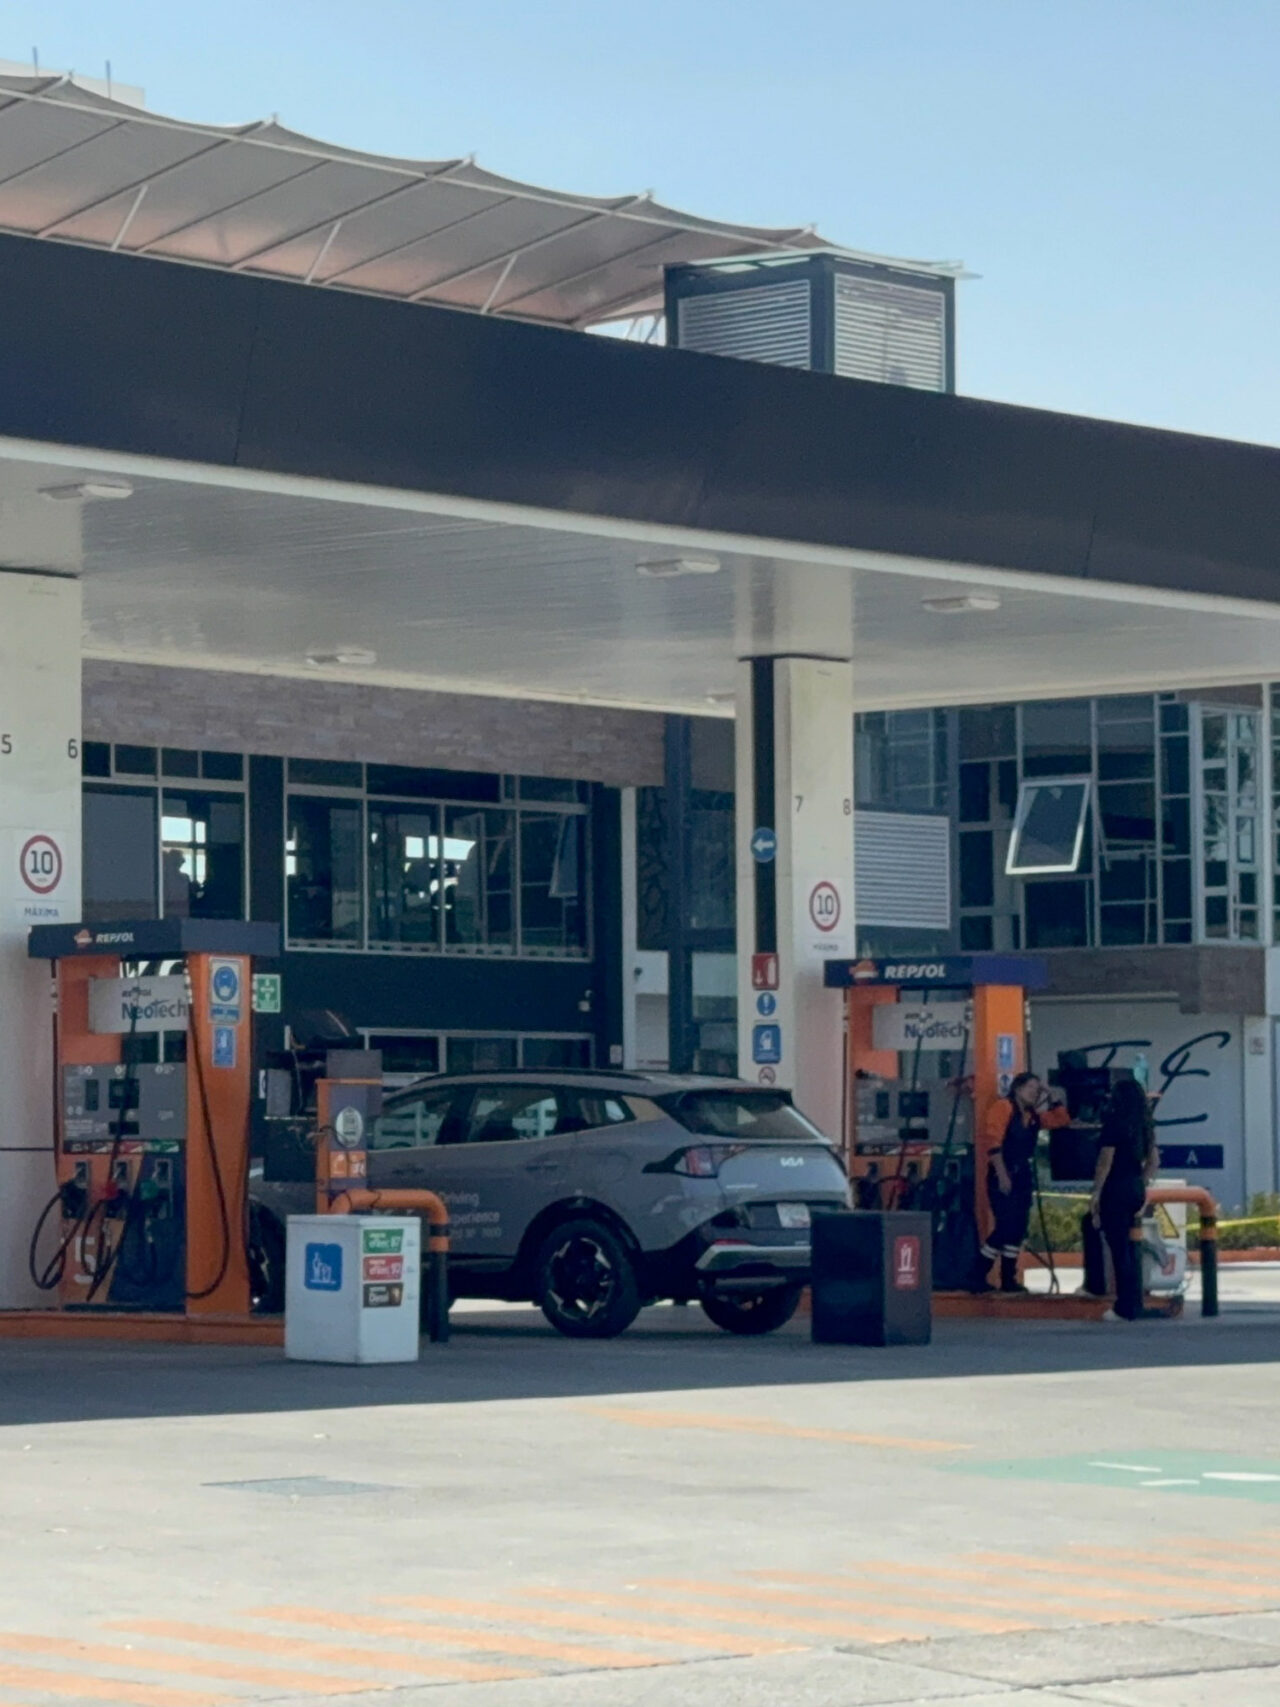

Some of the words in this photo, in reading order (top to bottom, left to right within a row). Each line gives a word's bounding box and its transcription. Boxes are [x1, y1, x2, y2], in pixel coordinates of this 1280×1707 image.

[1, 734, 12, 754] 5
[68, 738, 78, 759] 6
[794, 795, 804, 813] 7
[842, 798, 851, 816] 8
[30, 850, 54, 875] 10
[816, 894, 835, 915] 10
[95, 932, 135, 943] REPSOL
[884, 964, 947, 979] REPSOL
